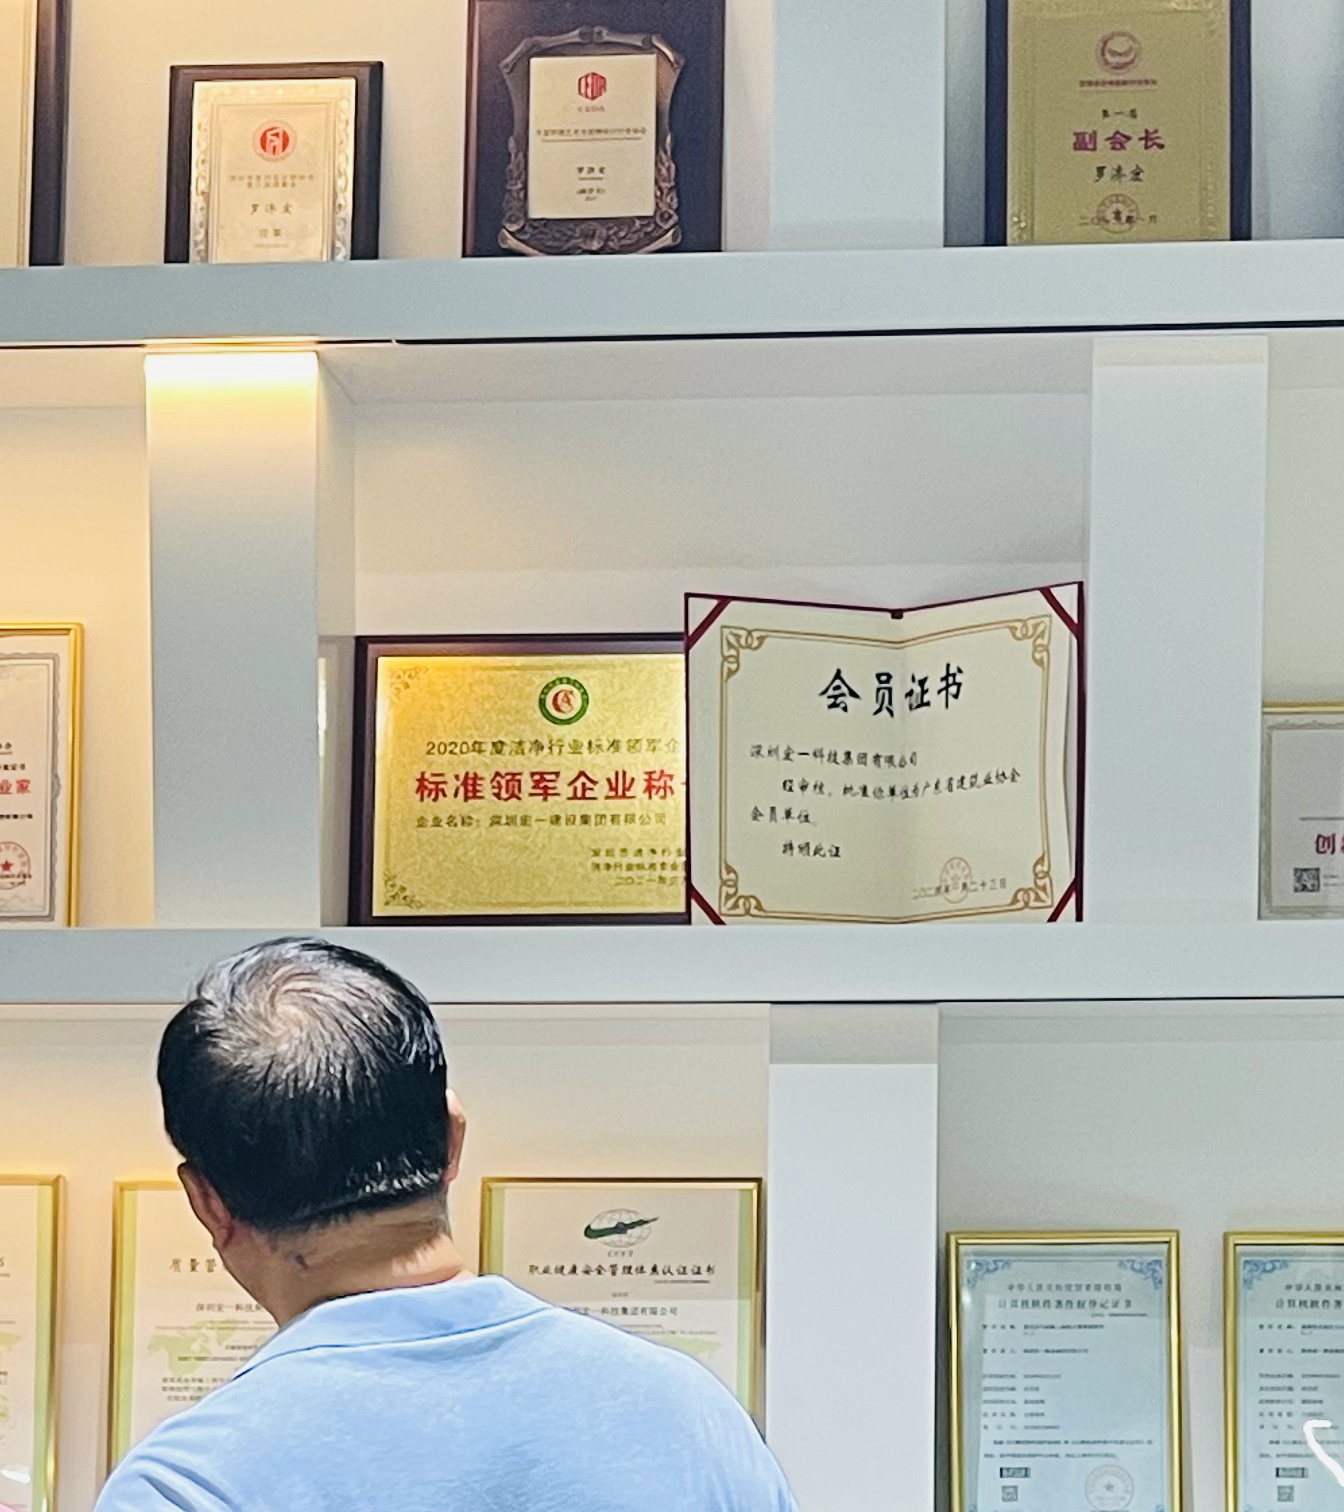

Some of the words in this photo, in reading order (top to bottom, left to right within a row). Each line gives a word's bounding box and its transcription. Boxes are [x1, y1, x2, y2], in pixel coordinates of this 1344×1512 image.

[1073, 128, 1165, 151] 副会长
[818, 663, 964, 718] 会员证书
[750, 744, 918, 767] 深圳宏一科技集团有限公司
[415, 769, 687, 802] 标准领军企业称
